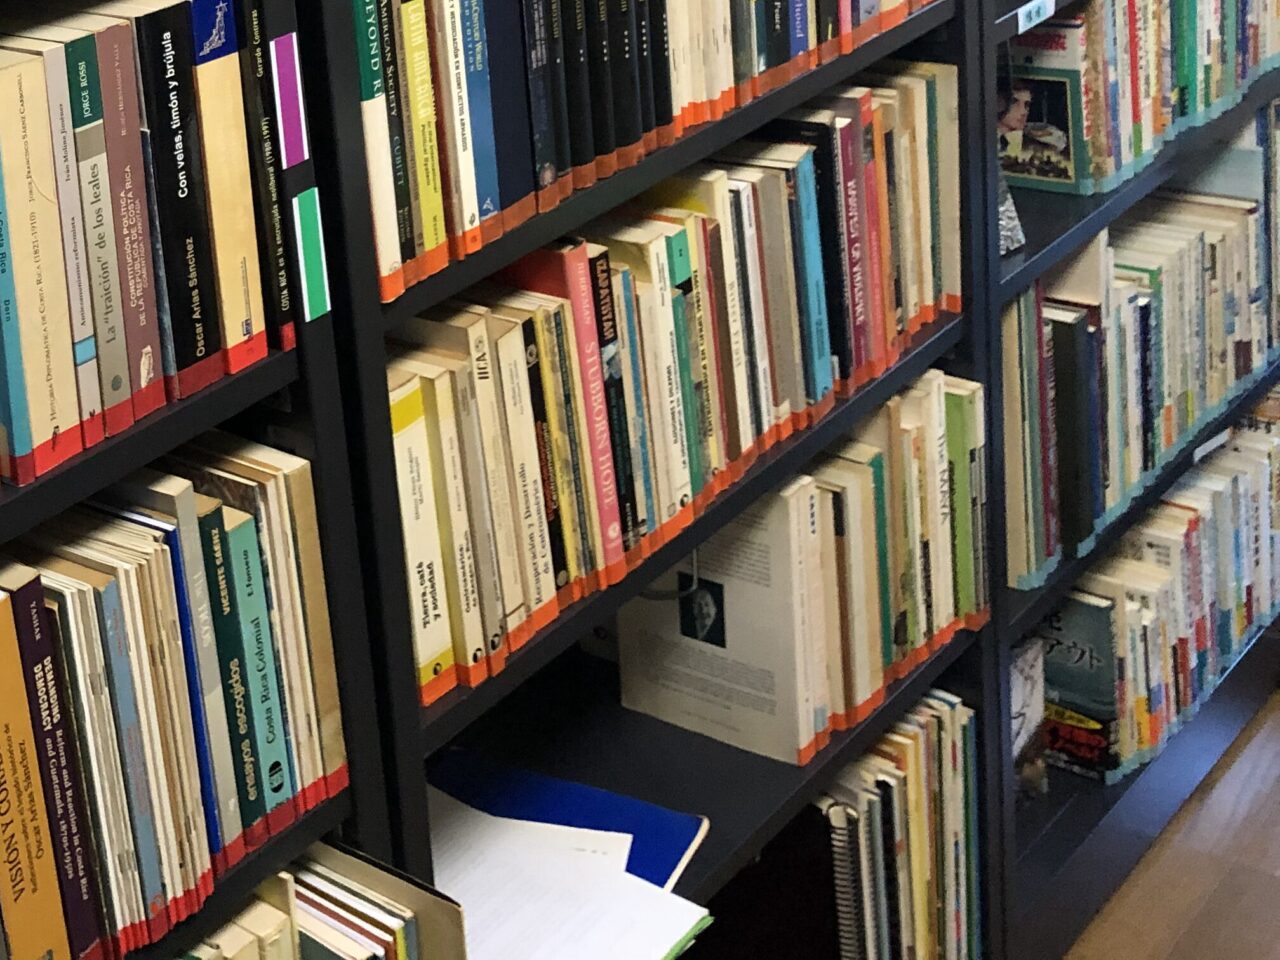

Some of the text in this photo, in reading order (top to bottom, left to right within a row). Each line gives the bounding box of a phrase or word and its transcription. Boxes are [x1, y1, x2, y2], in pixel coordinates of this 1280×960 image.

[79, 61, 93, 118] JORGE ROSSI
[163, 31, 188, 199] Con velas, timón brújula
[386, 60, 398, 118] SOCIETY
[394, 136, 405, 185] CUBITT
[91, 163, 102, 201] leales
[123, 242, 137, 307] CONSTITUCIÓN
[185, 237, 206, 358] Oscar Sánchez
[476, 352, 490, 380] IICA
[584, 341, 616, 509] STUBBORN HOPE
[33, 663, 53, 733] DEMOCRACY
[43, 655, 61, 725] DEMANDING
[251, 616, 275, 745] Costa Rica Colonial
[229, 657, 257, 801] ensayos escogidos
[19, 739, 36, 795] Sánchez
[3, 839, 26, 904] VISIÓN
